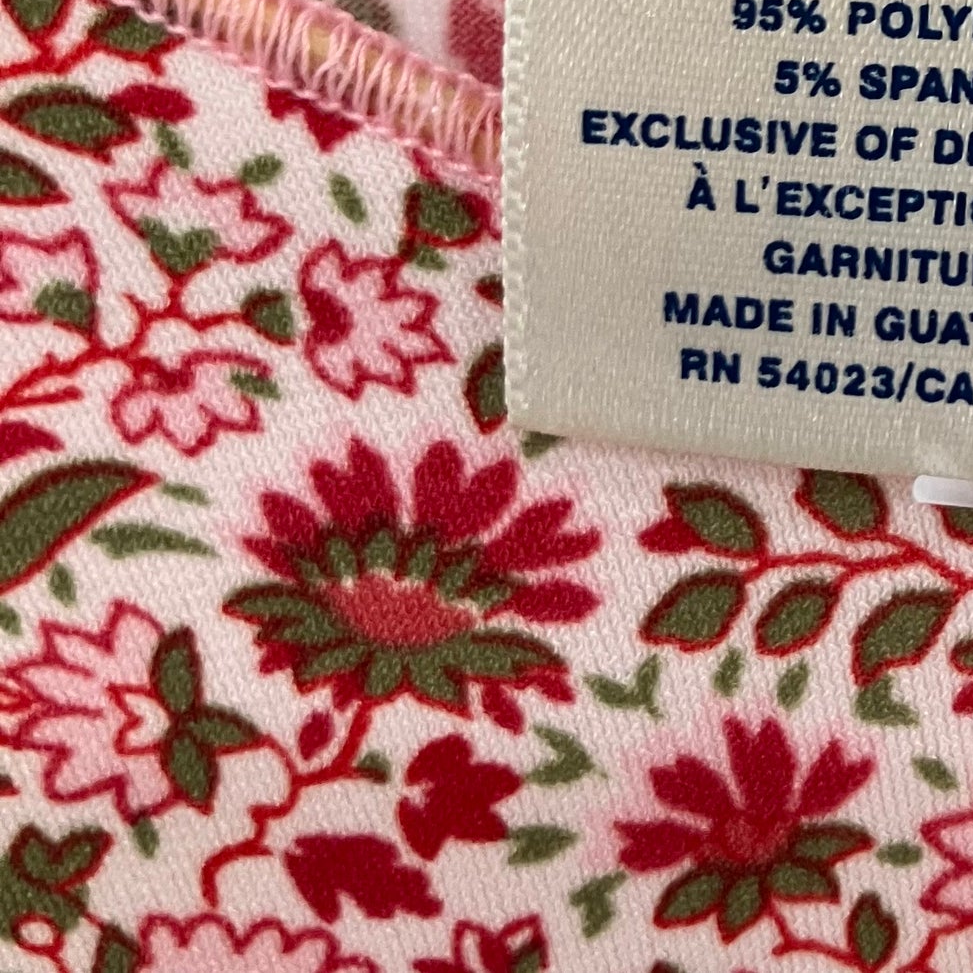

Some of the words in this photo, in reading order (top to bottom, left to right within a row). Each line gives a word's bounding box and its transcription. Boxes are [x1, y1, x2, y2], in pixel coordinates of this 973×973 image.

[775, 60, 841, 97] 5%
[582, 110, 837, 158] EXCLUSIVE
[856, 125, 917, 161] OF
[686, 162, 715, 211] À
[664, 292, 793, 333] MADE
[811, 303, 856, 337] IN
[681, 348, 740, 384] RN
